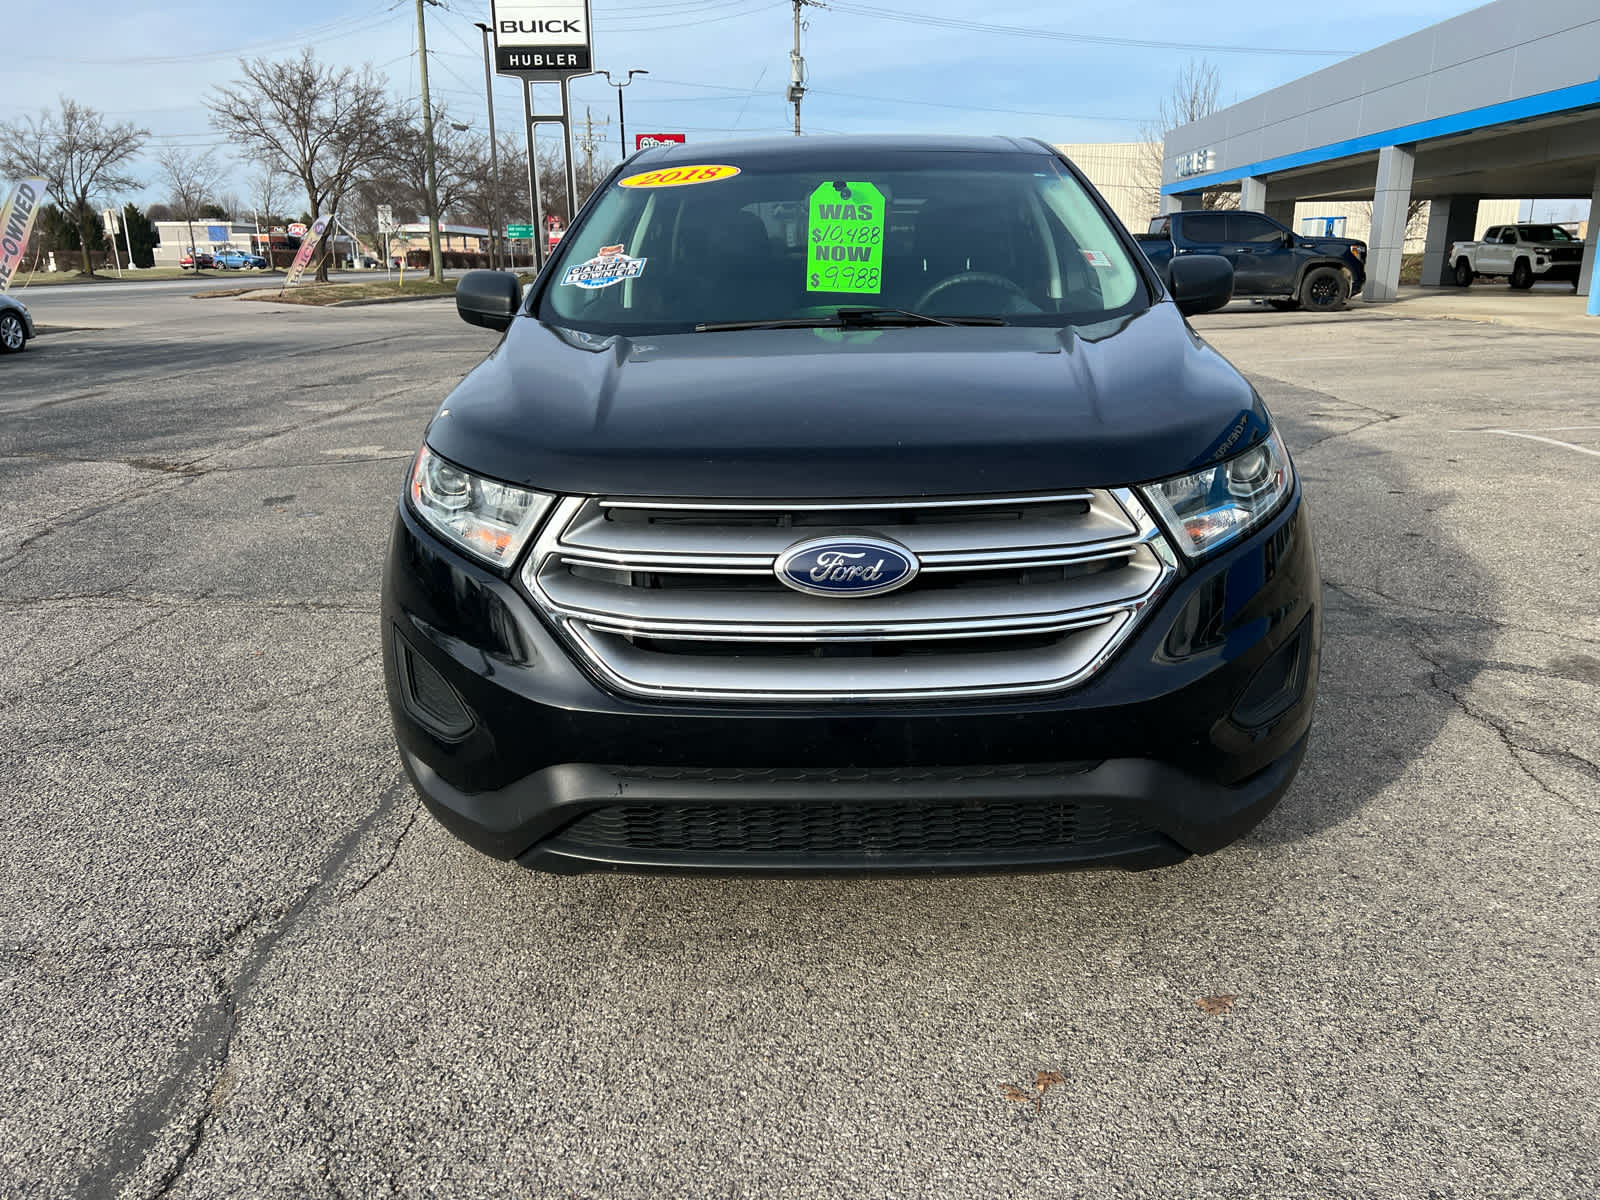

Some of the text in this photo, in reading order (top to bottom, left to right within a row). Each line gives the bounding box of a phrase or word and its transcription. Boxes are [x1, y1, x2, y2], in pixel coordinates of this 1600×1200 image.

[500, 20, 581, 33] BUICK
[509, 54, 577, 66] HUBLER
[637, 167, 722, 185] 2018
[819, 204, 872, 221] WAS
[812, 224, 880, 244] $10,488
[815, 245, 872, 262] NOW
[810, 551, 884, 582] Ford
